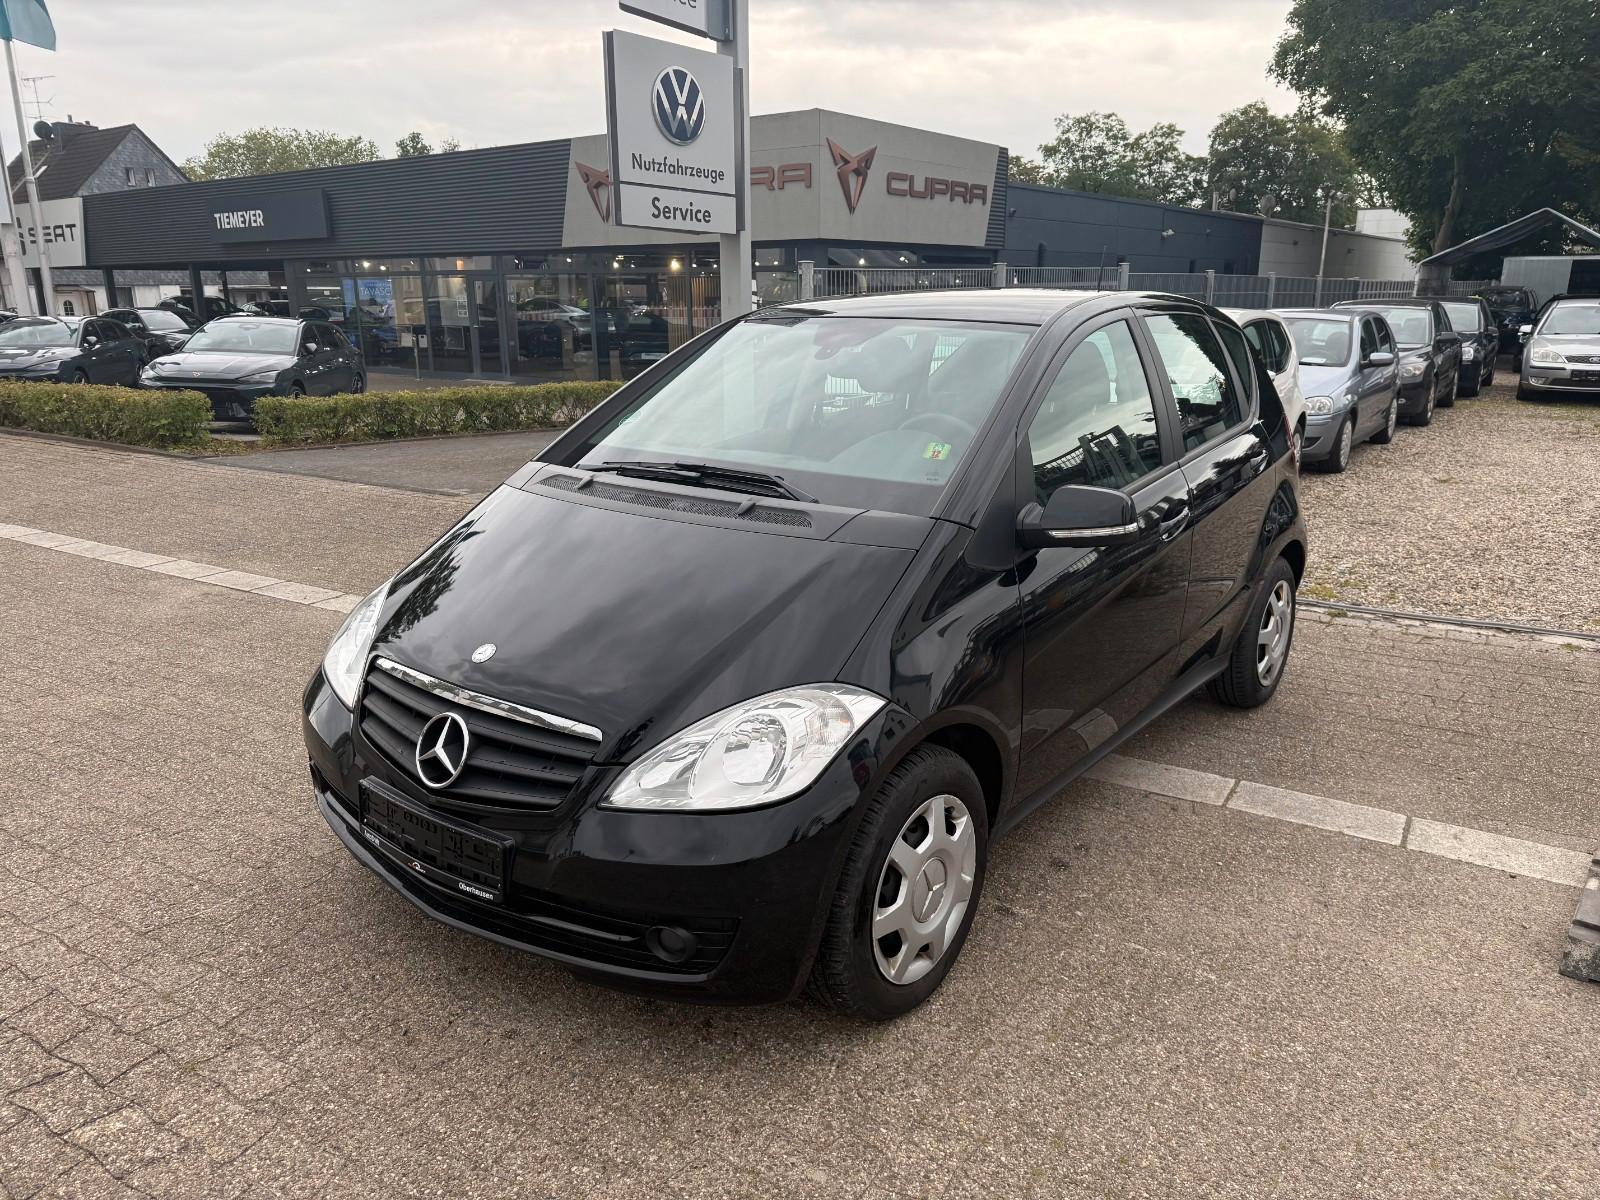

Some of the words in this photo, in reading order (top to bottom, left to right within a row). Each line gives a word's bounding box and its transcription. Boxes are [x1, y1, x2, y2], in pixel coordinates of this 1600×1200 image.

[632, 153, 725, 184] Nutzfahrzeuge
[886, 171, 988, 206] CUPRA
[213, 209, 265, 230] TIEMEYER
[651, 196, 712, 223] Service
[28, 223, 77, 244] SEAT
[458, 882, 494, 901] Oberhausen
